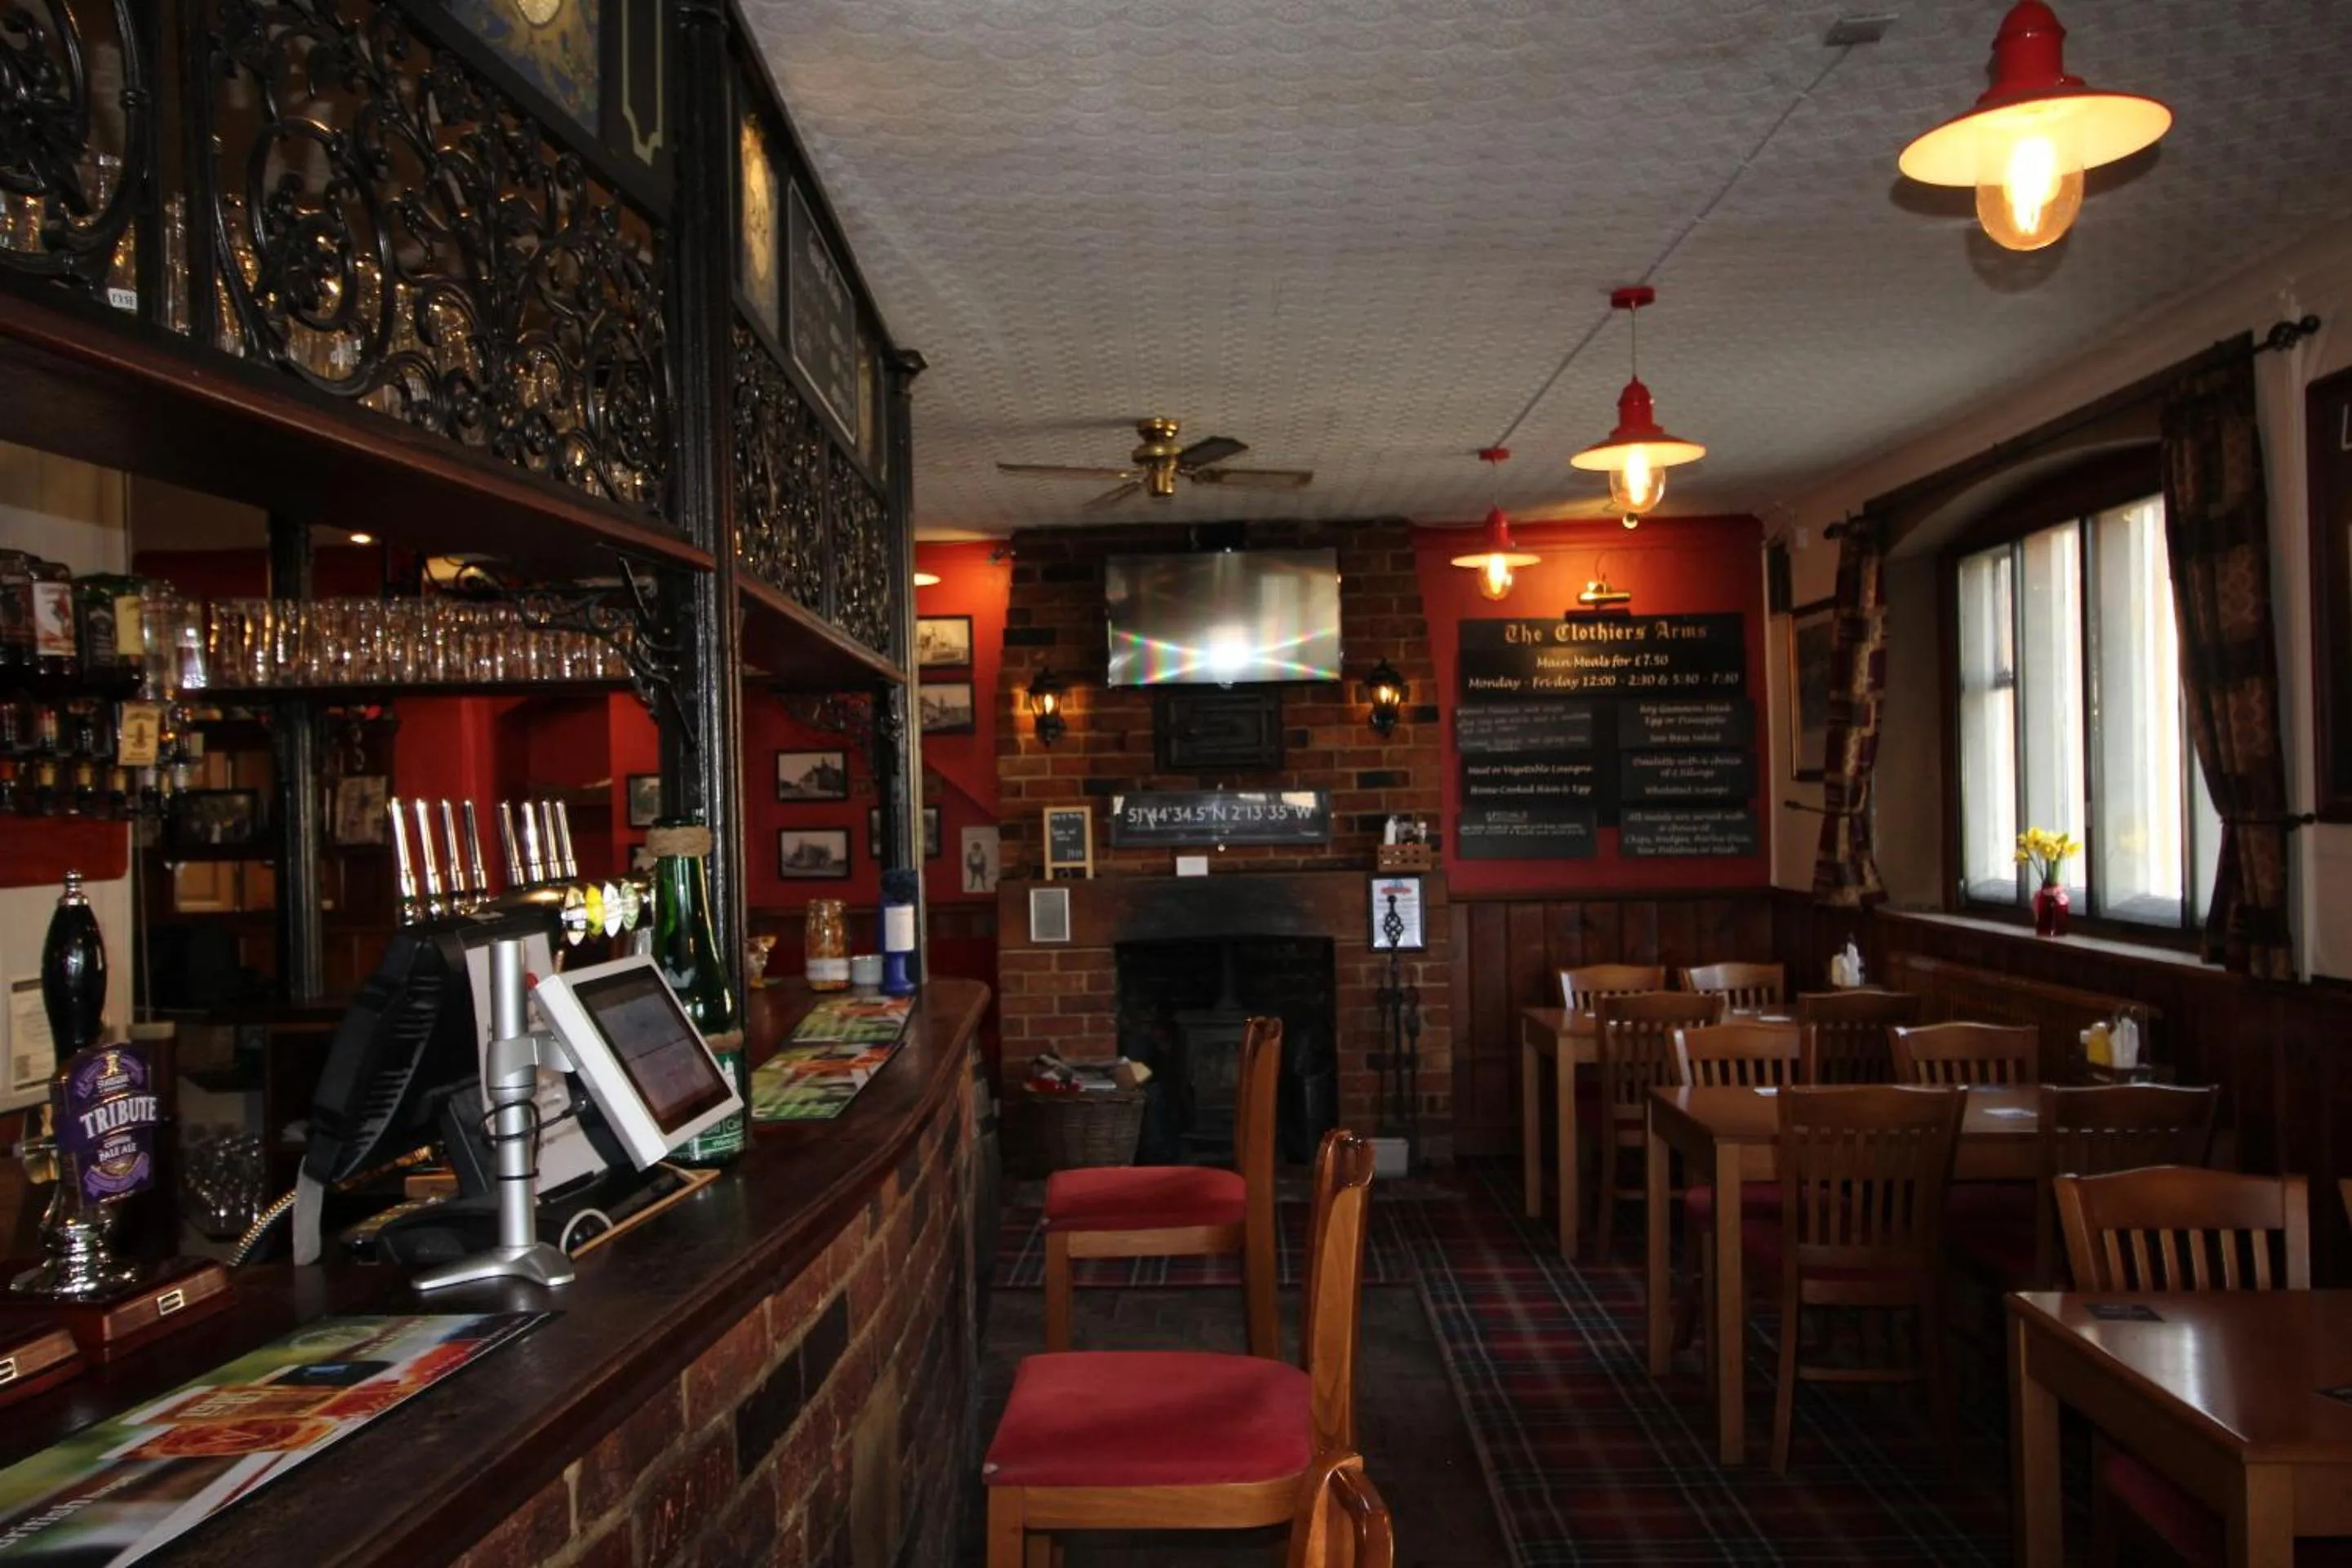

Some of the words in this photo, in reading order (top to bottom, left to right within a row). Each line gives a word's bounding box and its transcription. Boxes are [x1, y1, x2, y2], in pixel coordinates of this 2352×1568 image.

[1505, 624, 1543, 645] The
[1554, 622, 1647, 643] Clothiers
[1655, 620, 1708, 640] Arms
[1536, 655, 1572, 669] Main
[1573, 655, 1610, 669] Meals
[1611, 655, 1633, 669] for
[1469, 677, 1522, 691] Monday
[1532, 674, 1579, 691] Friday
[1582, 675, 1616, 687] 12:00
[79, 1097, 157, 1139] TRIBUTE
[121, 1142, 137, 1155] ALE
